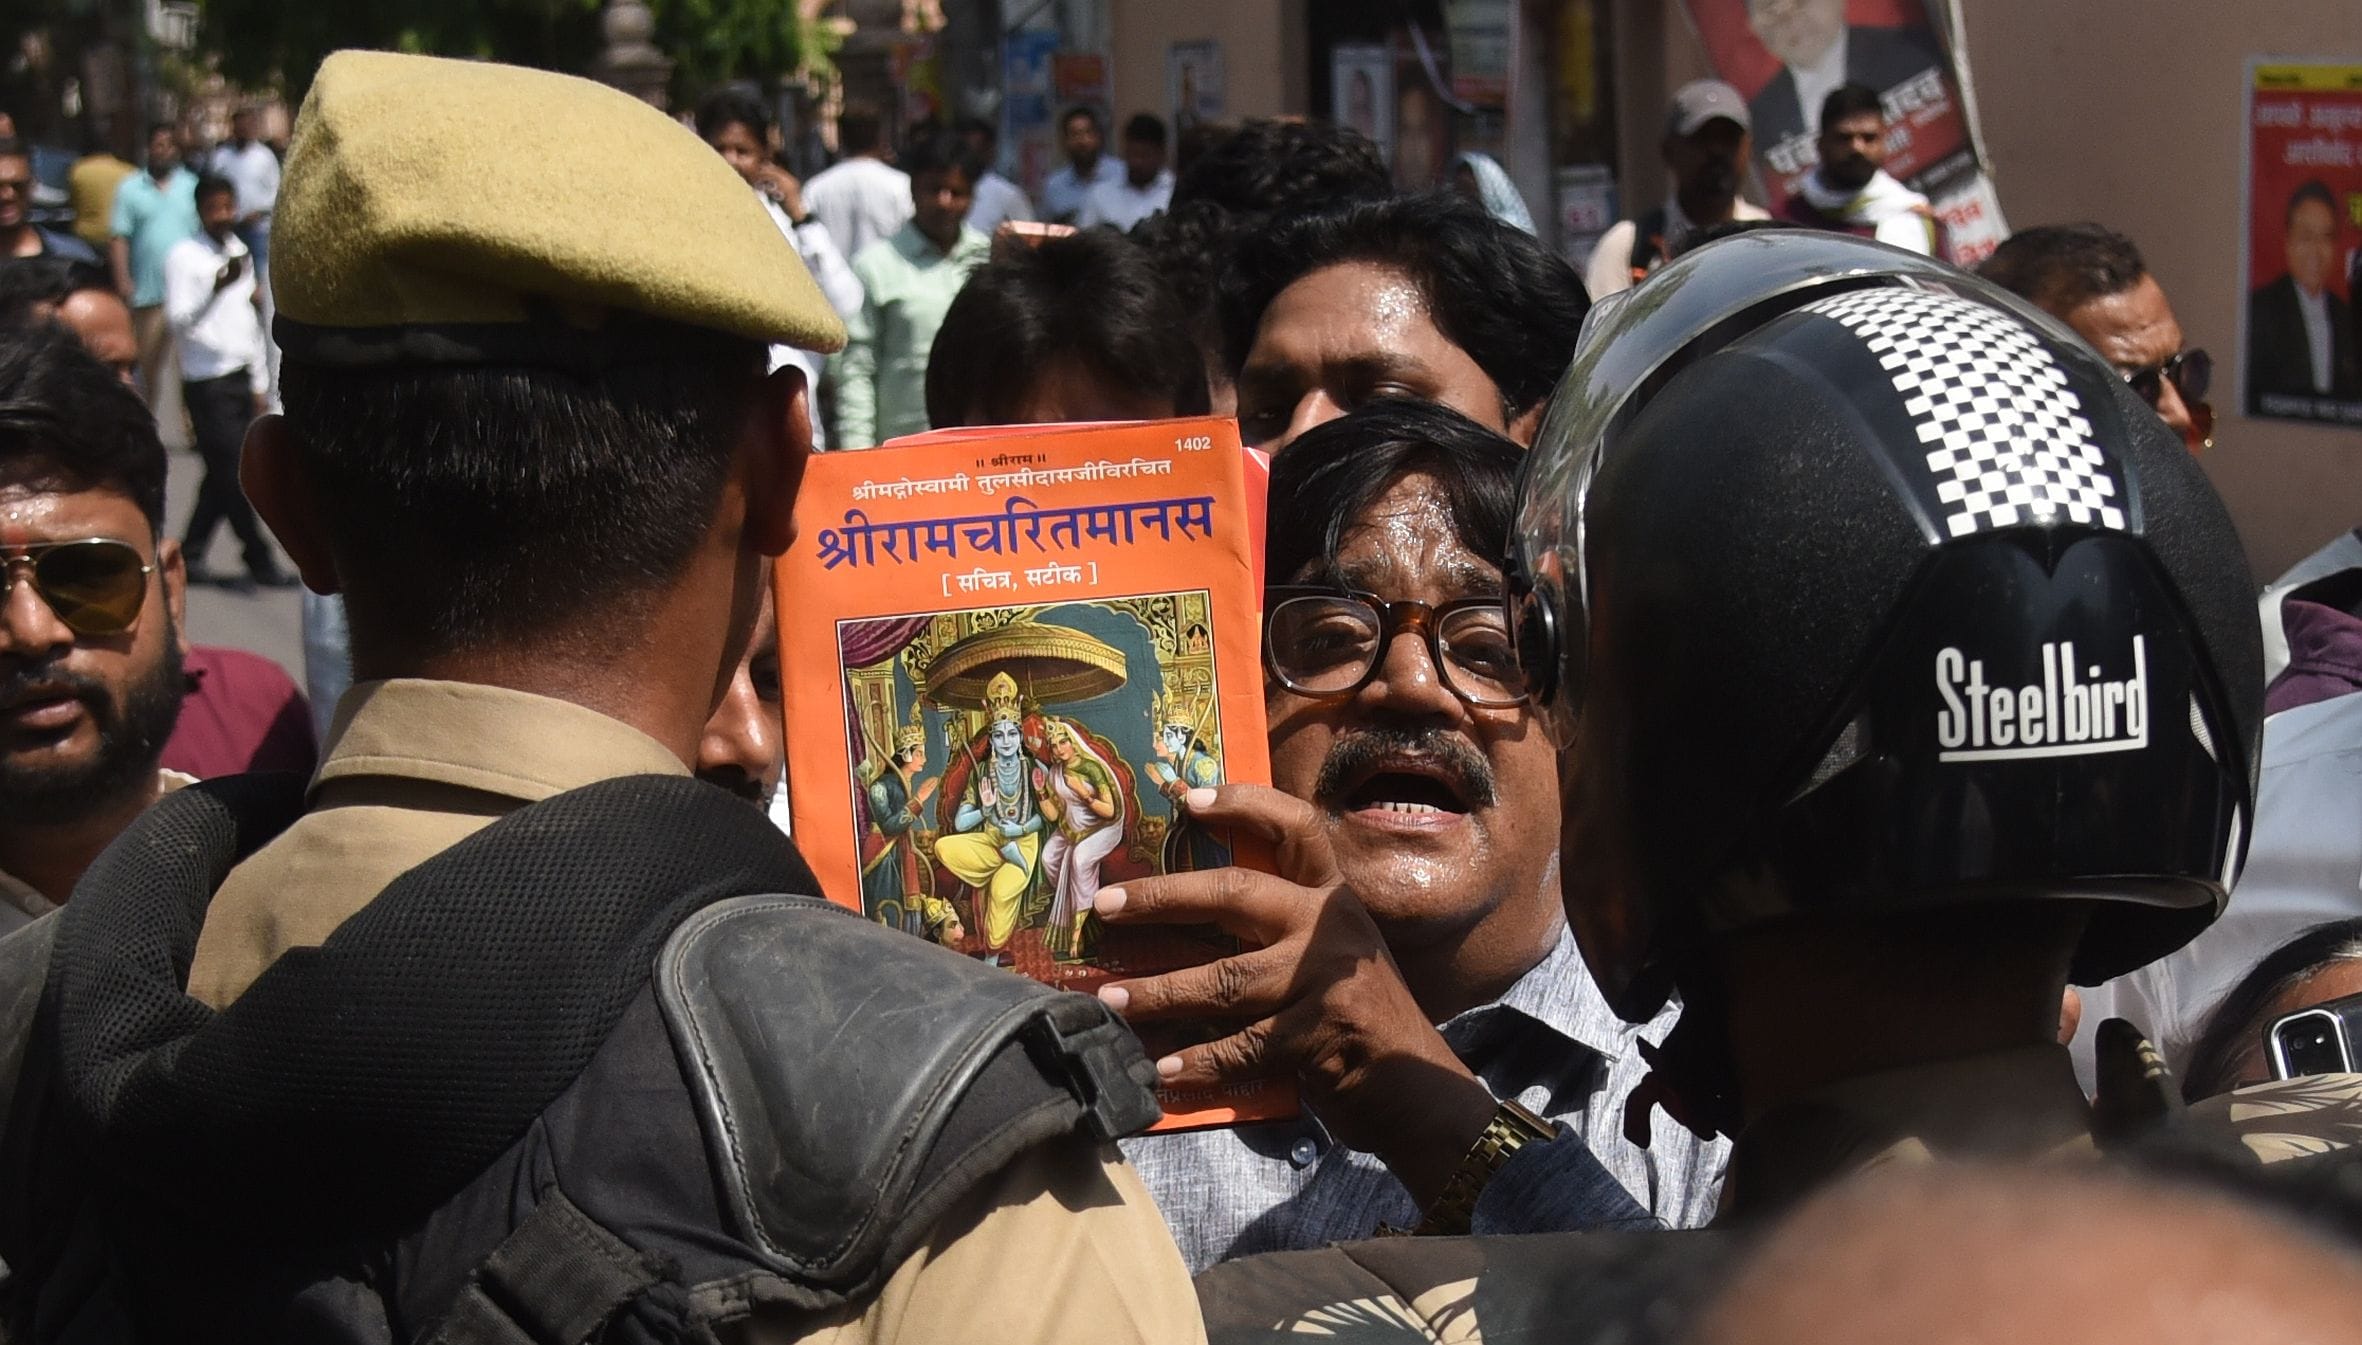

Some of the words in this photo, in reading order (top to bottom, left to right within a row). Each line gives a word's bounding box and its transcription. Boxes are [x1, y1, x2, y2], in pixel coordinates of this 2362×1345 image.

[991, 453, 1034, 467] श्रीराम
[1175, 436, 1212, 453] 1402
[852, 473, 970, 500] श्रीमद्गोस्वामी
[975, 458, 1172, 495] तुलसीदासजीविरचित
[816, 495, 1217, 571] श्रीरामचरितमानस
[956, 567, 1018, 592] सचित्र,
[1024, 562, 1082, 587] सटीक
[1935, 634, 2149, 750] Steelbird
